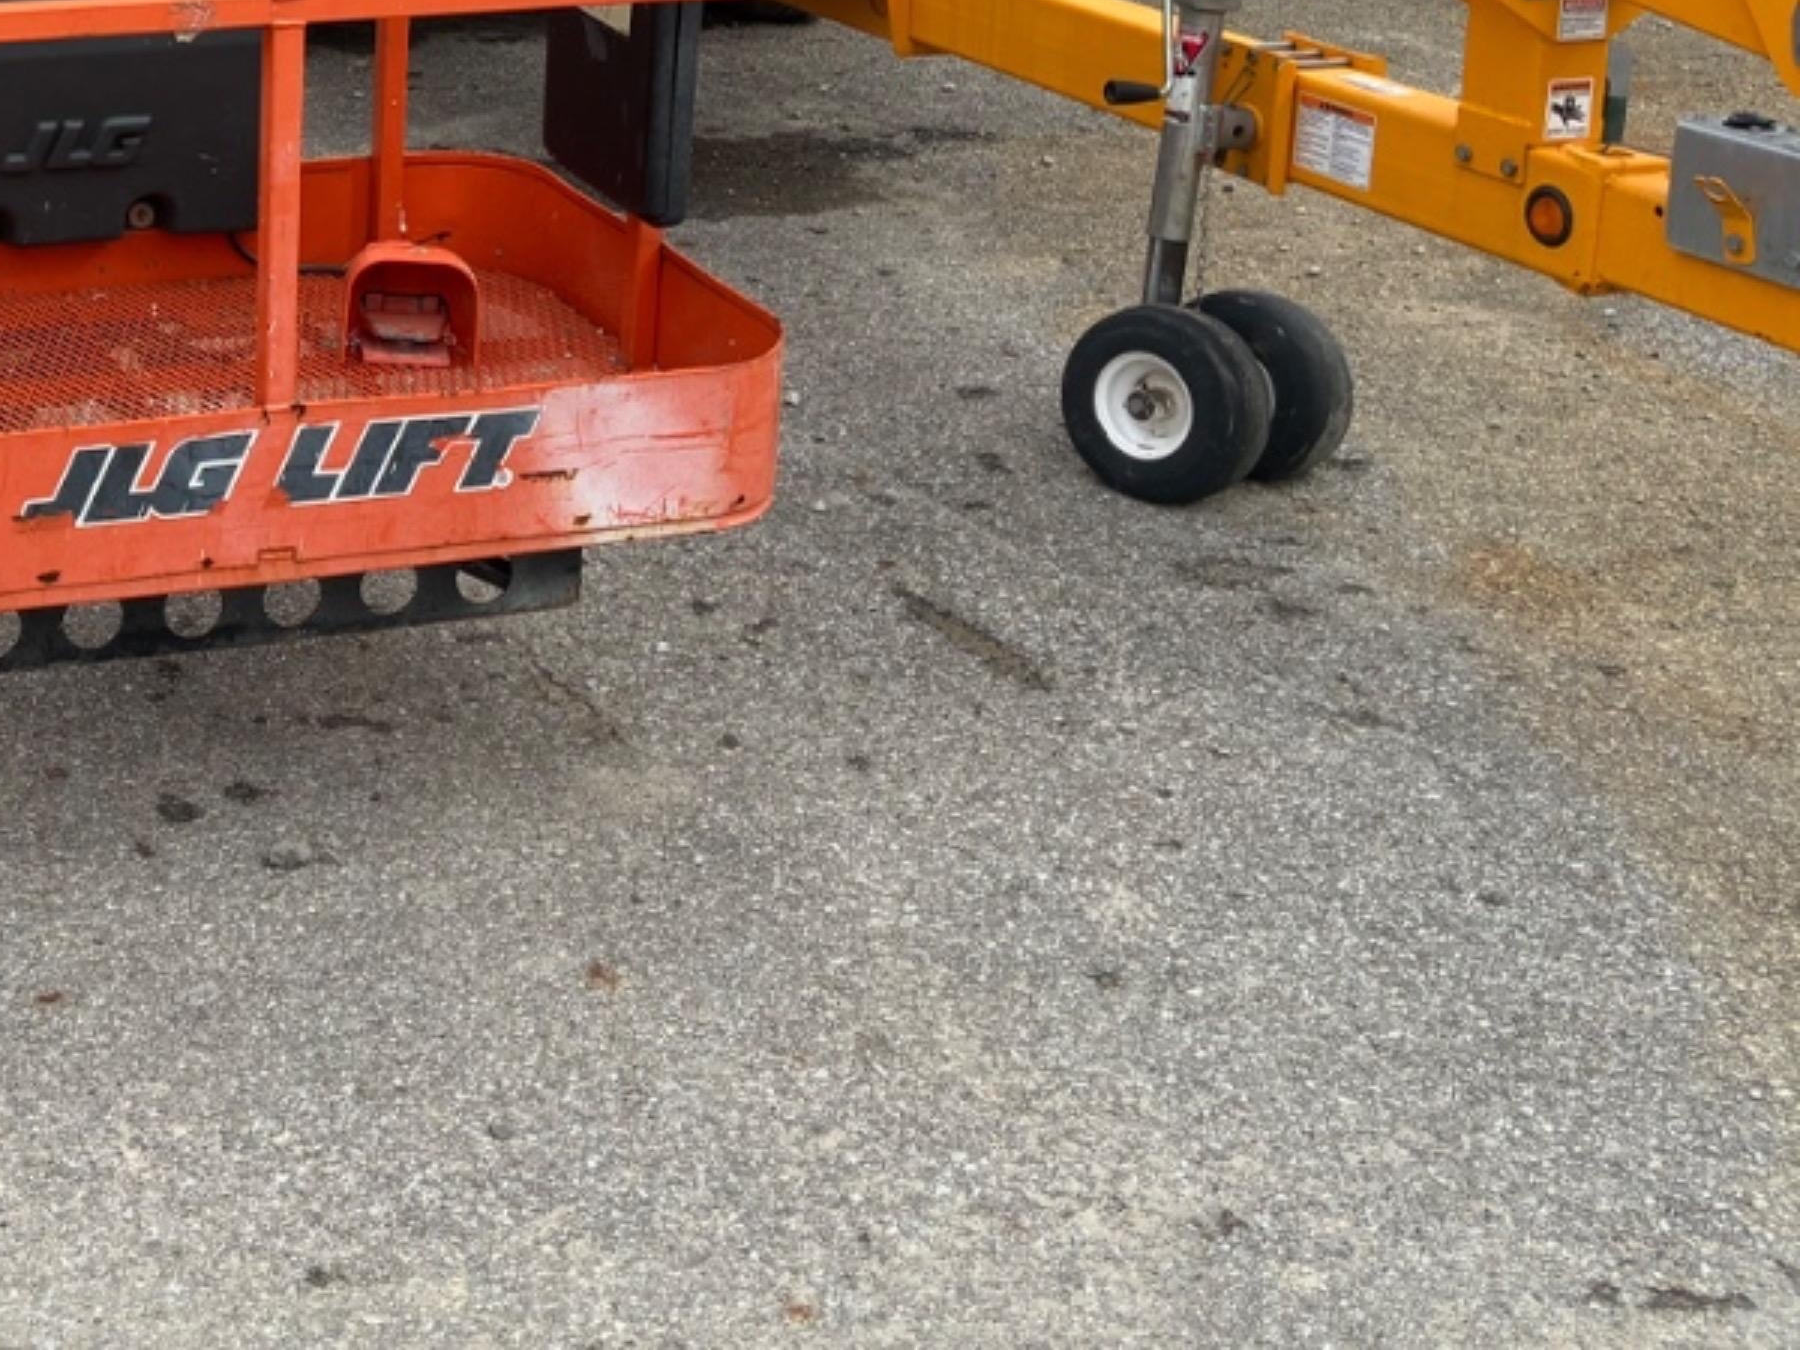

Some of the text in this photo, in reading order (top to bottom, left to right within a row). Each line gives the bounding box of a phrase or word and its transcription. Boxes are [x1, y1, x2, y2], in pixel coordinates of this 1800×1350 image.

[4, 114, 153, 170] JLG
[18, 404, 545, 528] JLG LIFT
